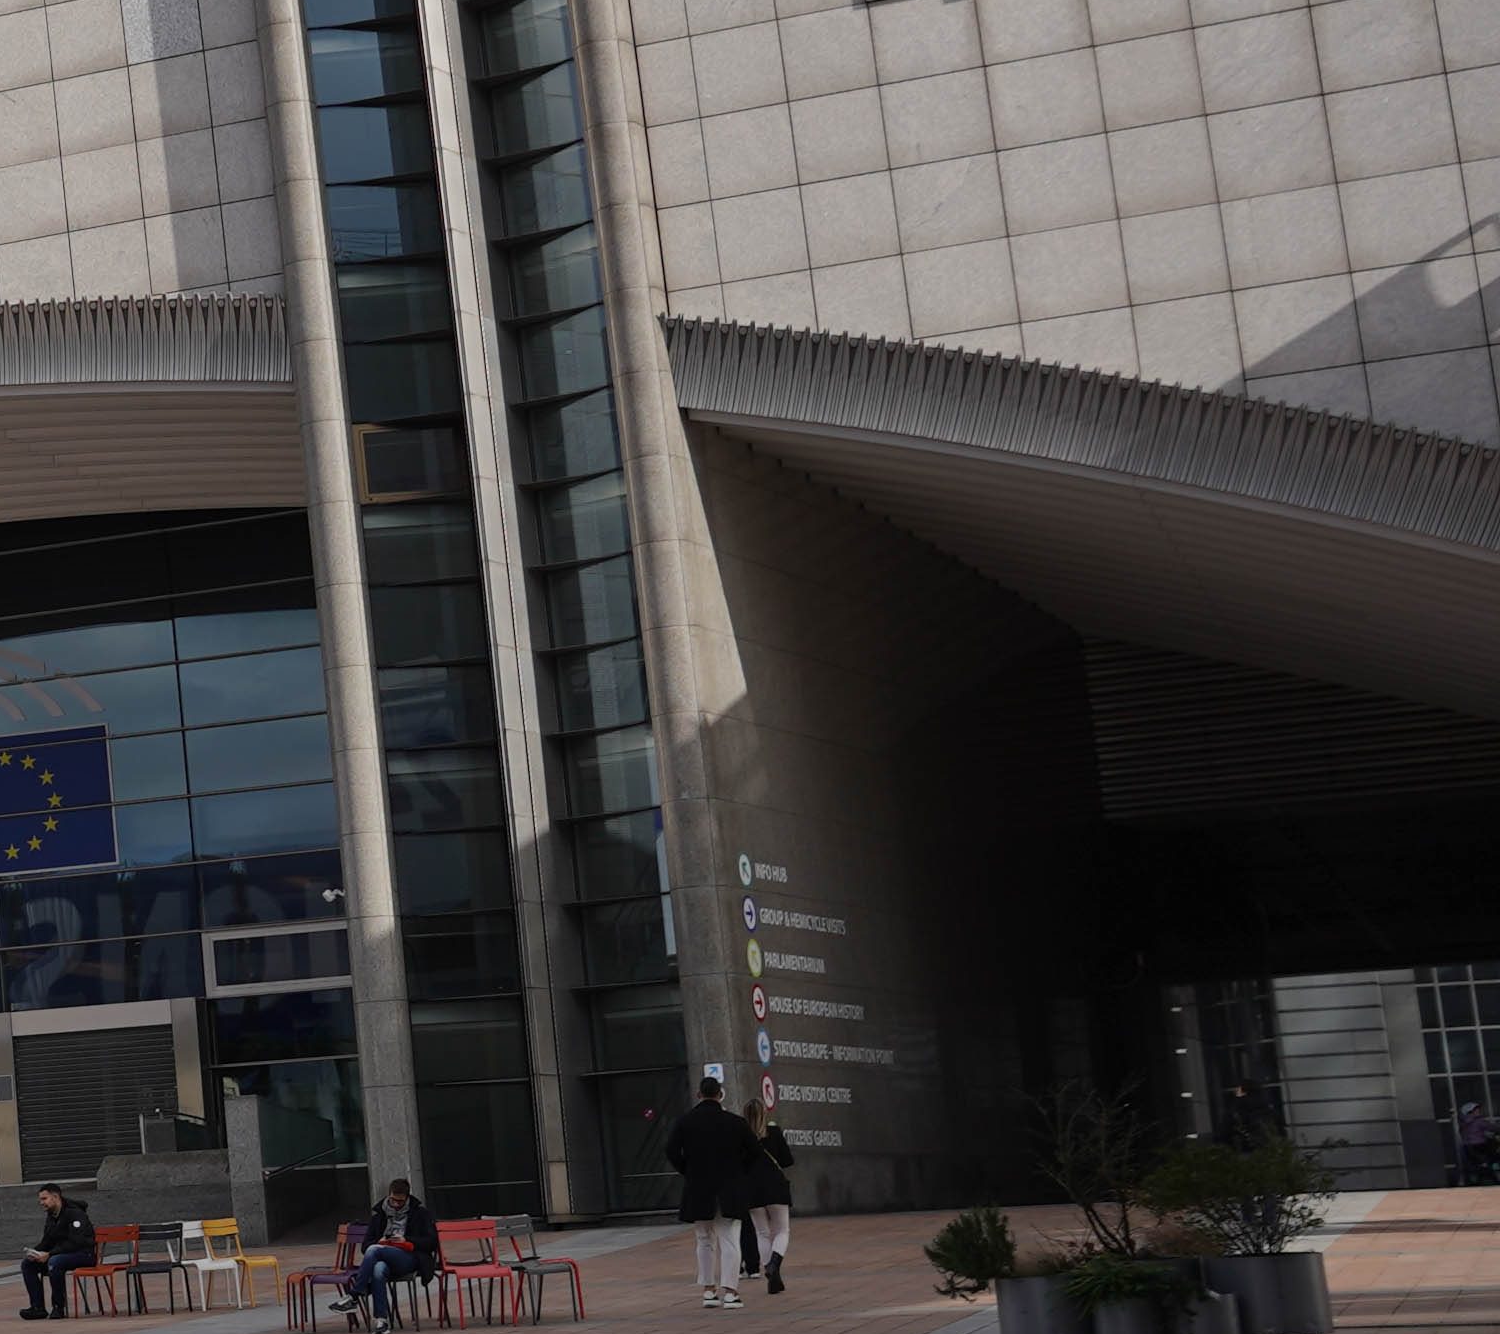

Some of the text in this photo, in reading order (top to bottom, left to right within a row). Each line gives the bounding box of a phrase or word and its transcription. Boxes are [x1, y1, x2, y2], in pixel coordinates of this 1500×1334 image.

[768, 996, 793, 1014] HOUSE
[793, 997, 802, 1015] OF
[803, 999, 838, 1018] EUROPEAN
[773, 1040, 802, 1058] STATION
[803, 1042, 829, 1059] EUROPE
